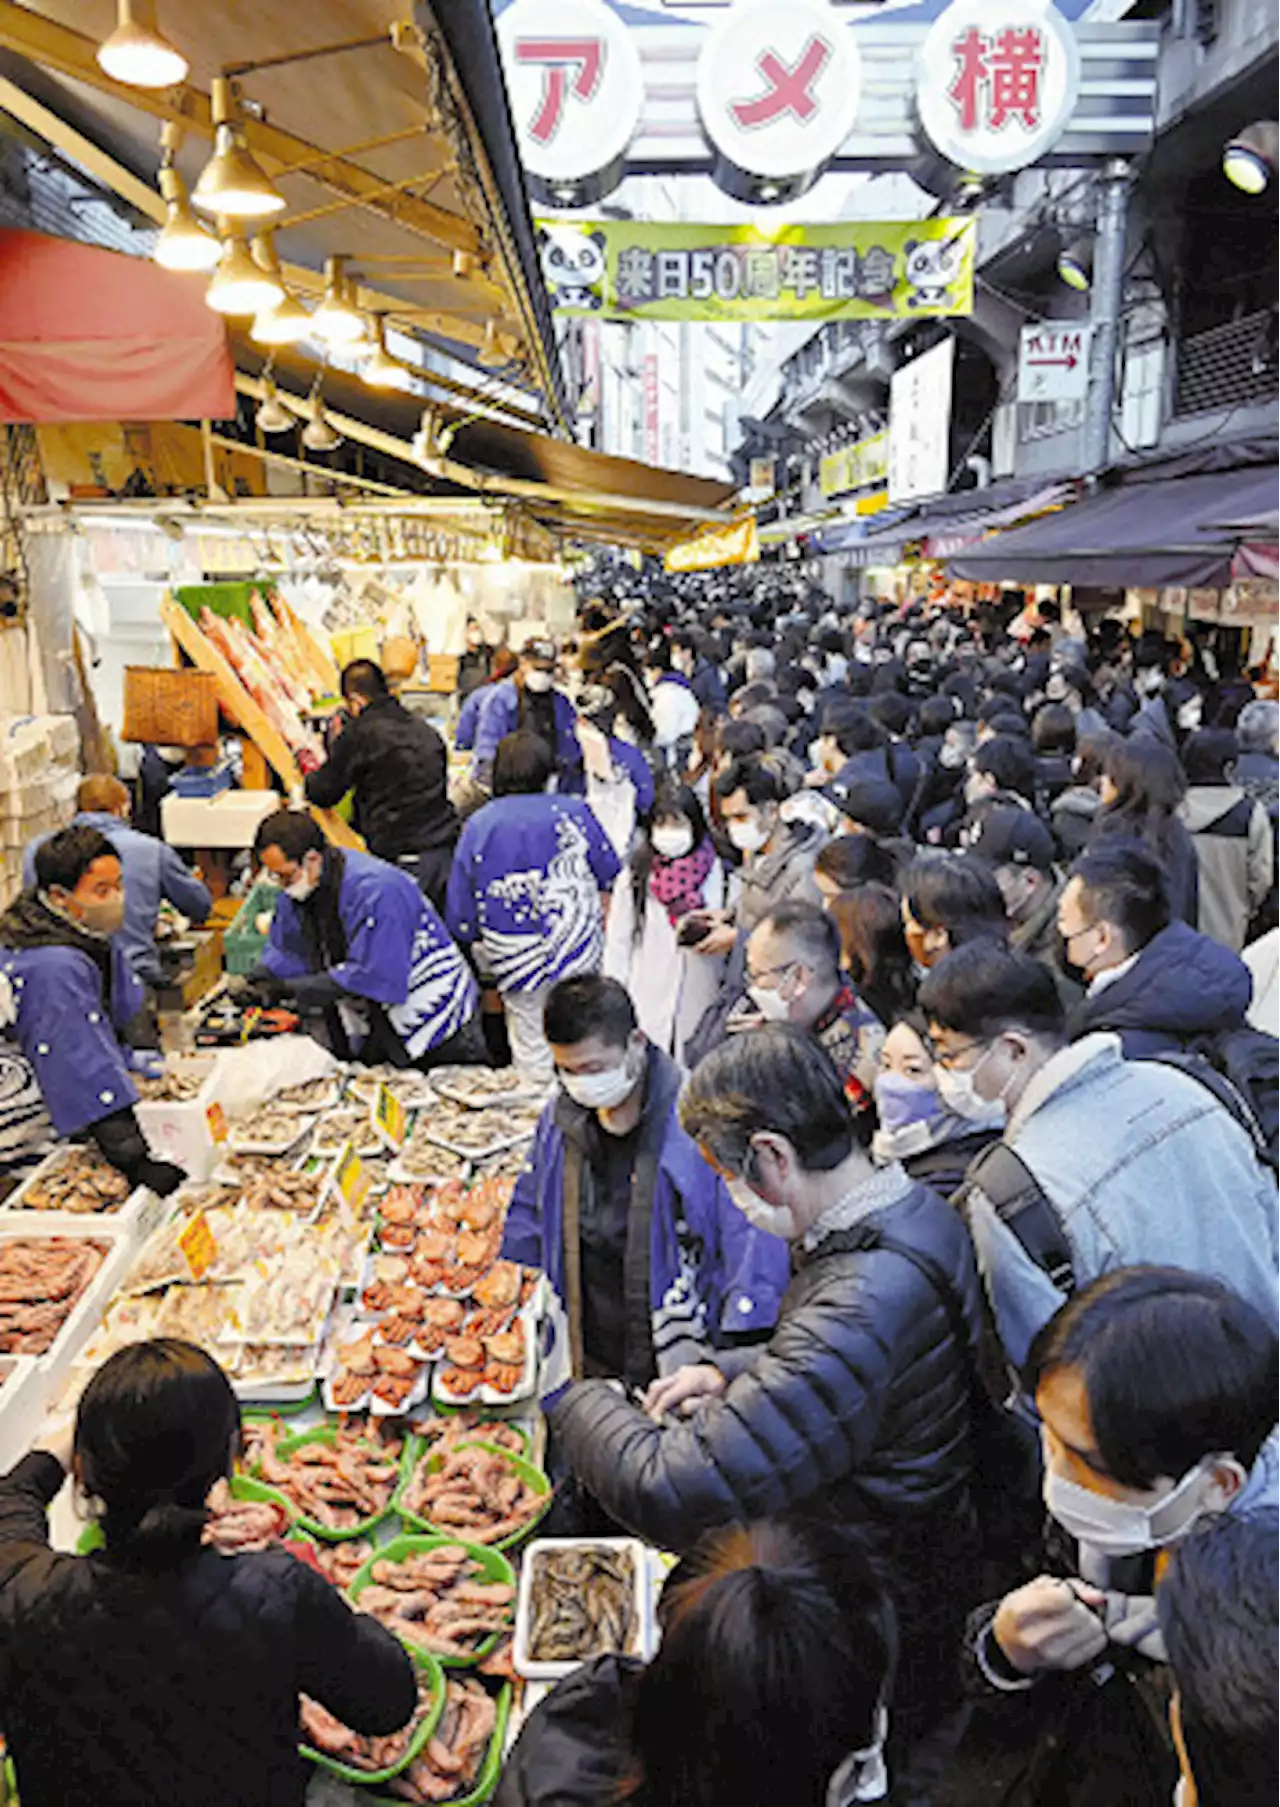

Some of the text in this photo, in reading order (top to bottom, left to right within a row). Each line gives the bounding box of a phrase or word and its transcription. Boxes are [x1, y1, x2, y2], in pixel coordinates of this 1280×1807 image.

[516, 26, 1043, 146] アメ横
[617, 245, 897, 299] 来日50周年記念
[1027, 333, 1081, 353] ATM
